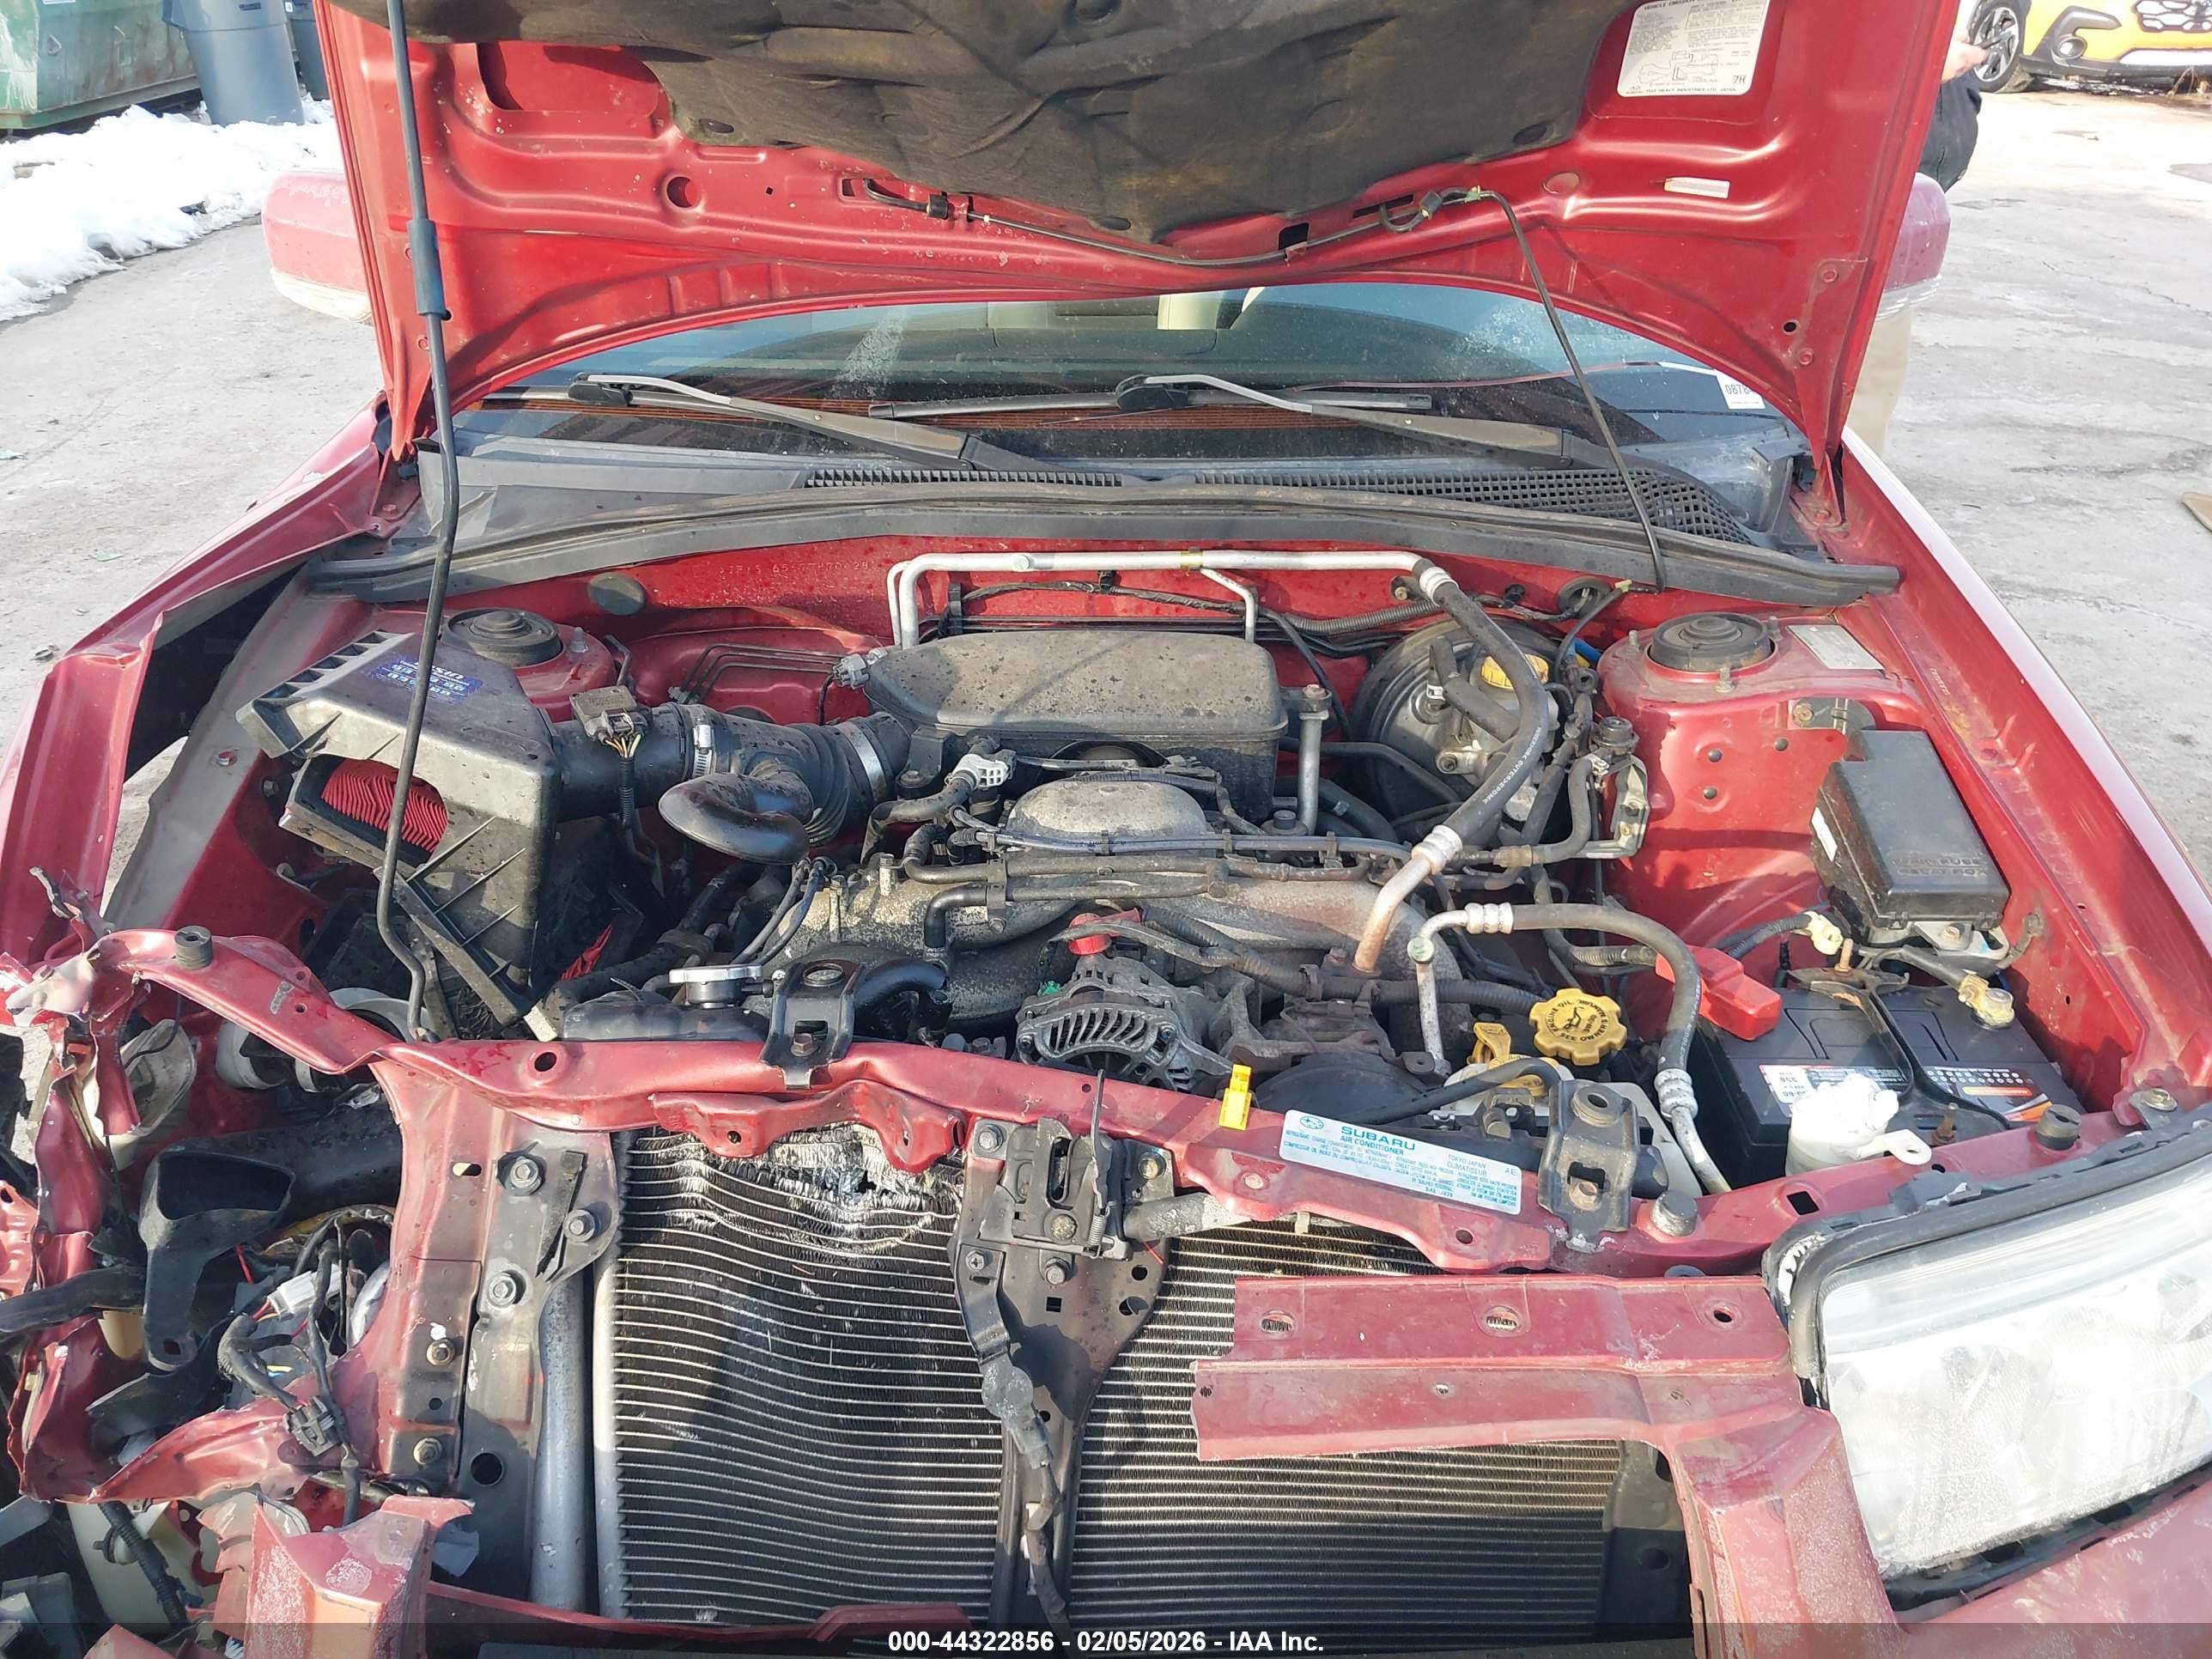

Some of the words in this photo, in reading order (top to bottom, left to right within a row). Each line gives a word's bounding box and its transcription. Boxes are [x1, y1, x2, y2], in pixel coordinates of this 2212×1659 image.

[1340, 1136, 1356, 1146] AIR
[1354, 1139, 1404, 1157] CONDITIONER
[1341, 1126, 1416, 1151] SUBARU
